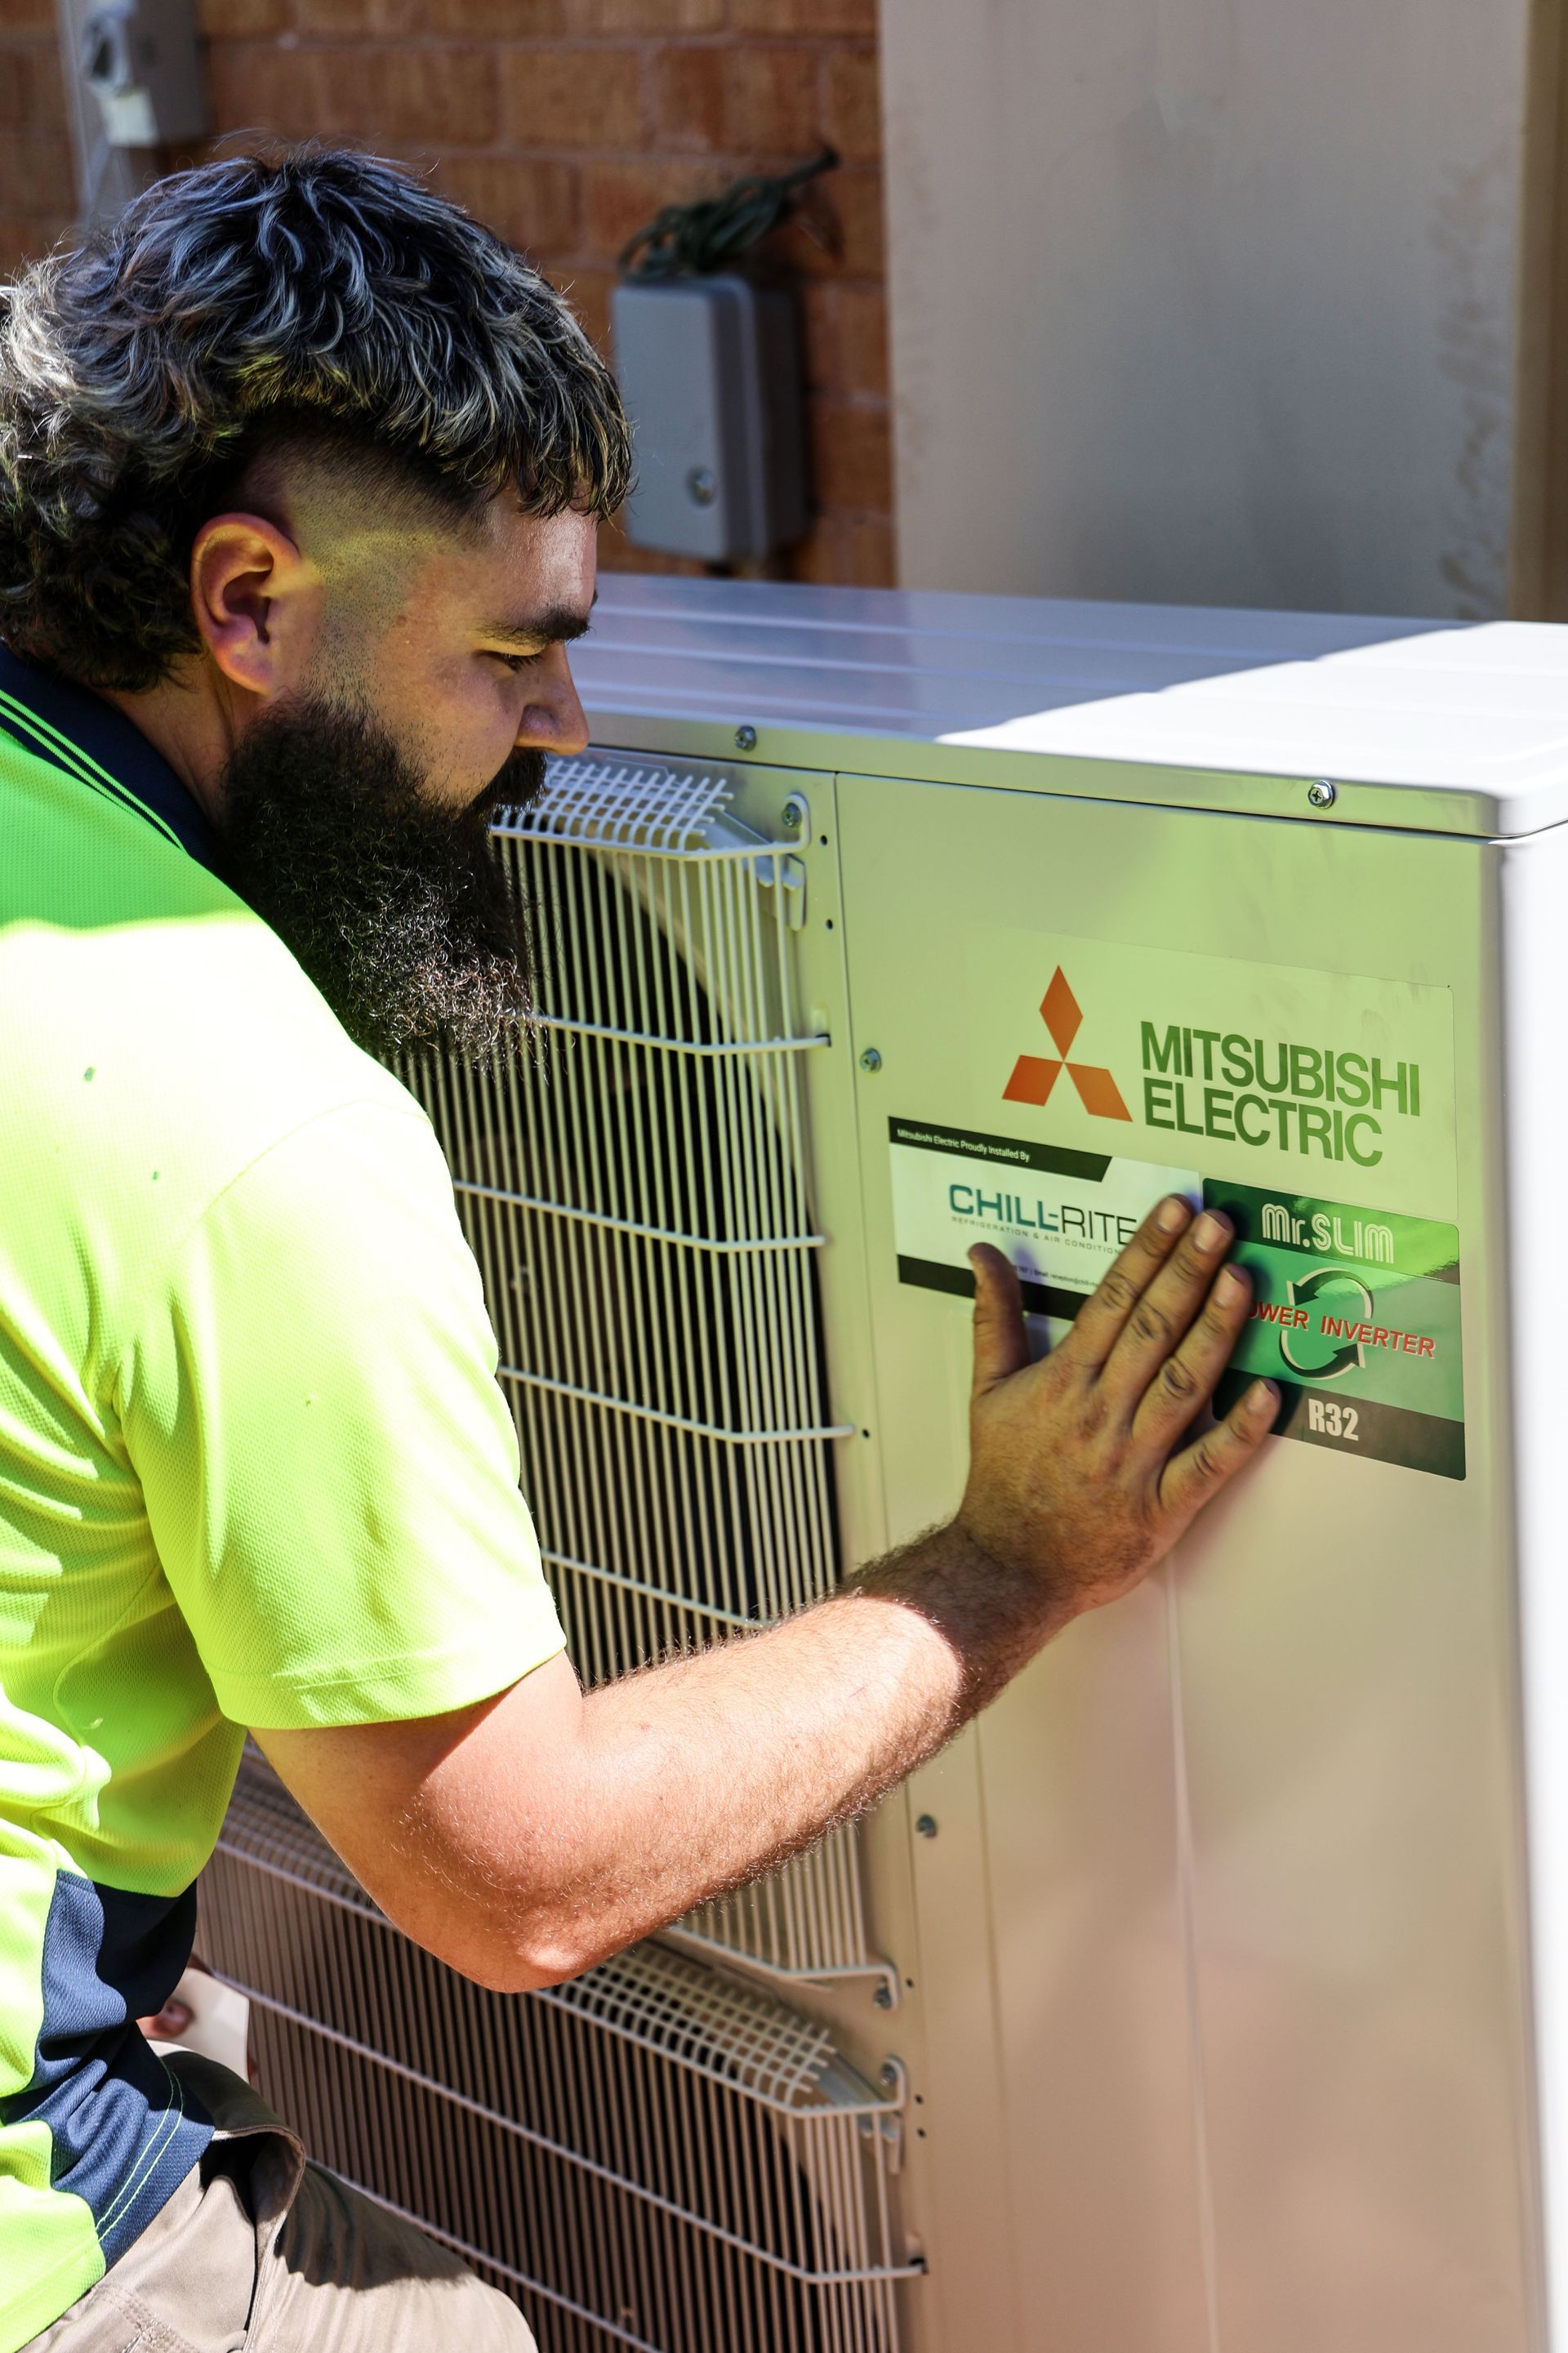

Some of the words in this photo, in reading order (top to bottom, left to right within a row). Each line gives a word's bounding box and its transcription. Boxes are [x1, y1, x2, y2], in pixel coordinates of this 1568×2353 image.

[1141, 1021, 1420, 1117] MITSUBISHI
[897, 1129, 933, 1143] Mitsubishi
[933, 1136, 960, 1149] Electric
[960, 1140, 987, 1155] Proudly
[988, 1145, 1019, 1160] Installed
[1020, 1151, 1030, 1162] By
[1143, 1079, 1383, 1167] ELECTRIC
[949, 1183, 1137, 1246] CHILL-RITE
[951, 1215, 1029, 1238] REFRIGERATION
[1033, 1232, 1040, 1240] &
[1044, 1235, 1061, 1244] AIR
[1064, 1239, 1121, 1256] CONDITION
[1261, 1203, 1395, 1264] Mr.SLIM
[1320, 1314, 1436, 1359] INVERTER
[1307, 1398, 1359, 1442] R32
